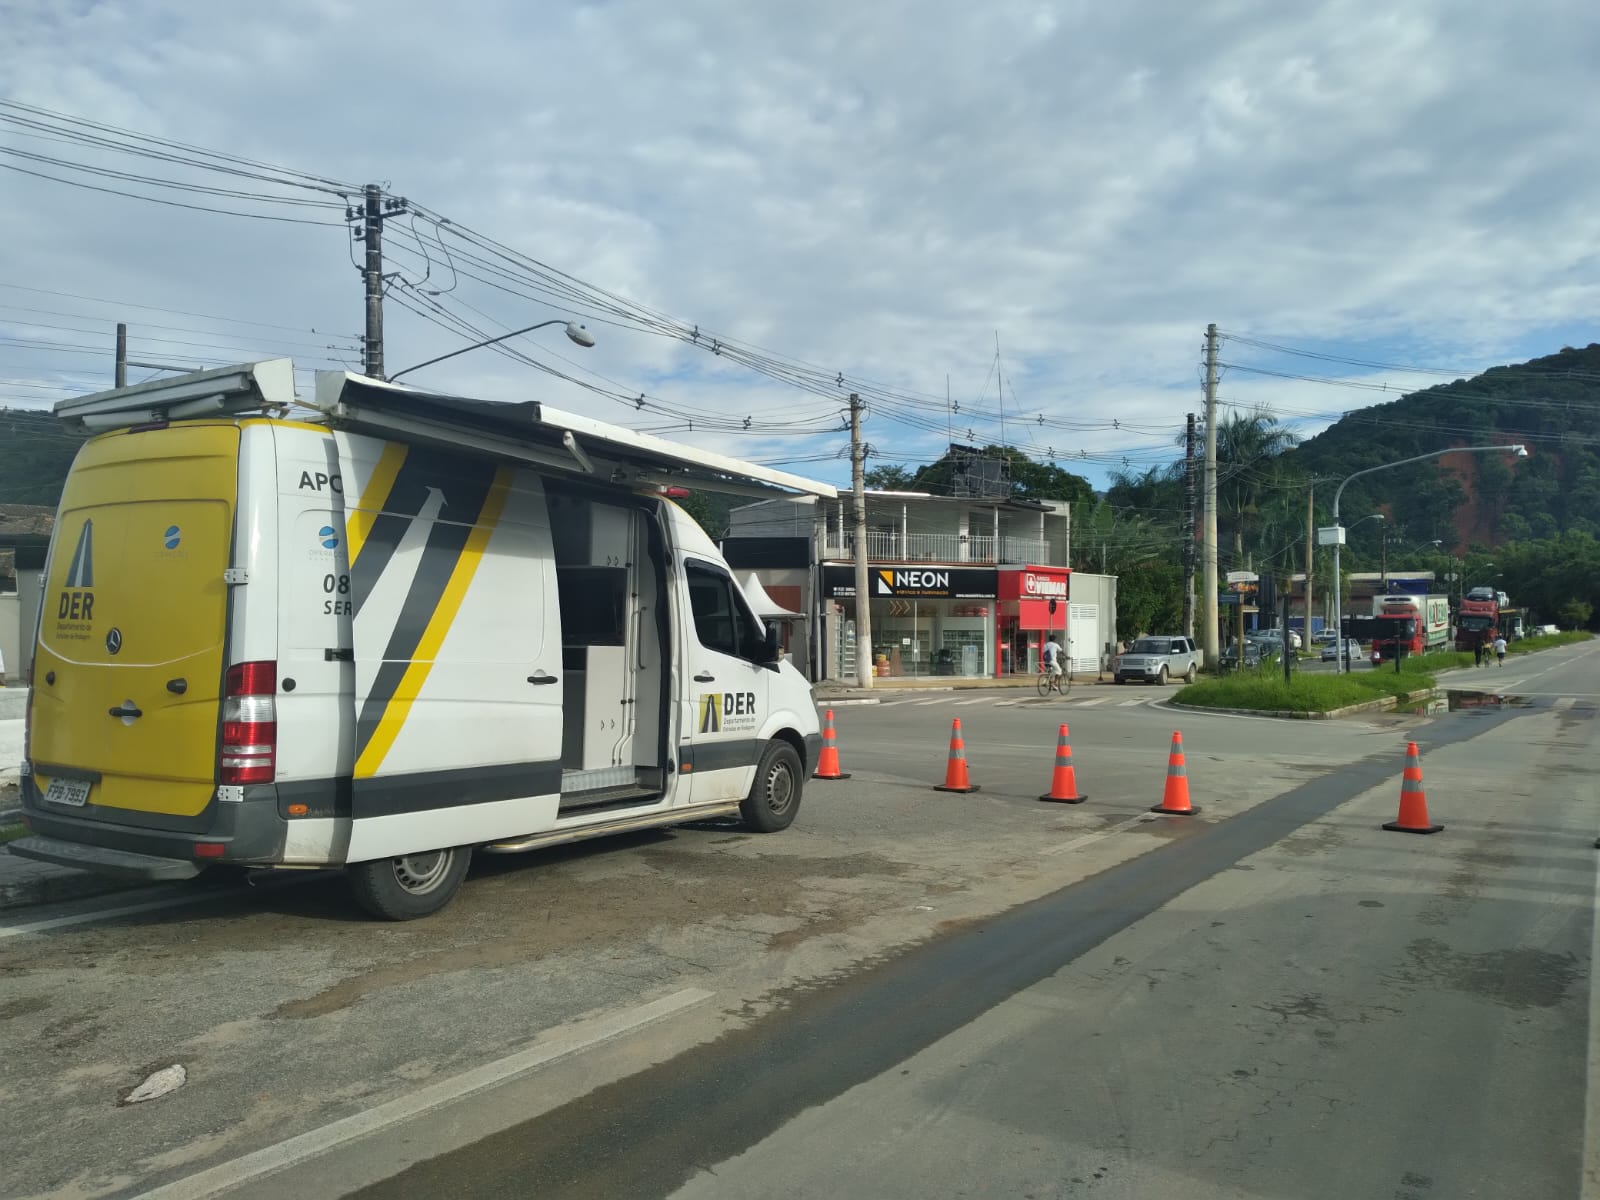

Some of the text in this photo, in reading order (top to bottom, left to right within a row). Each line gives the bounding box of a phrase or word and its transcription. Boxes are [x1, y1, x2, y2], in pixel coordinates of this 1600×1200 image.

[896, 571, 949, 588] NEON
[58, 591, 95, 620] DER
[724, 692, 756, 715] DER
